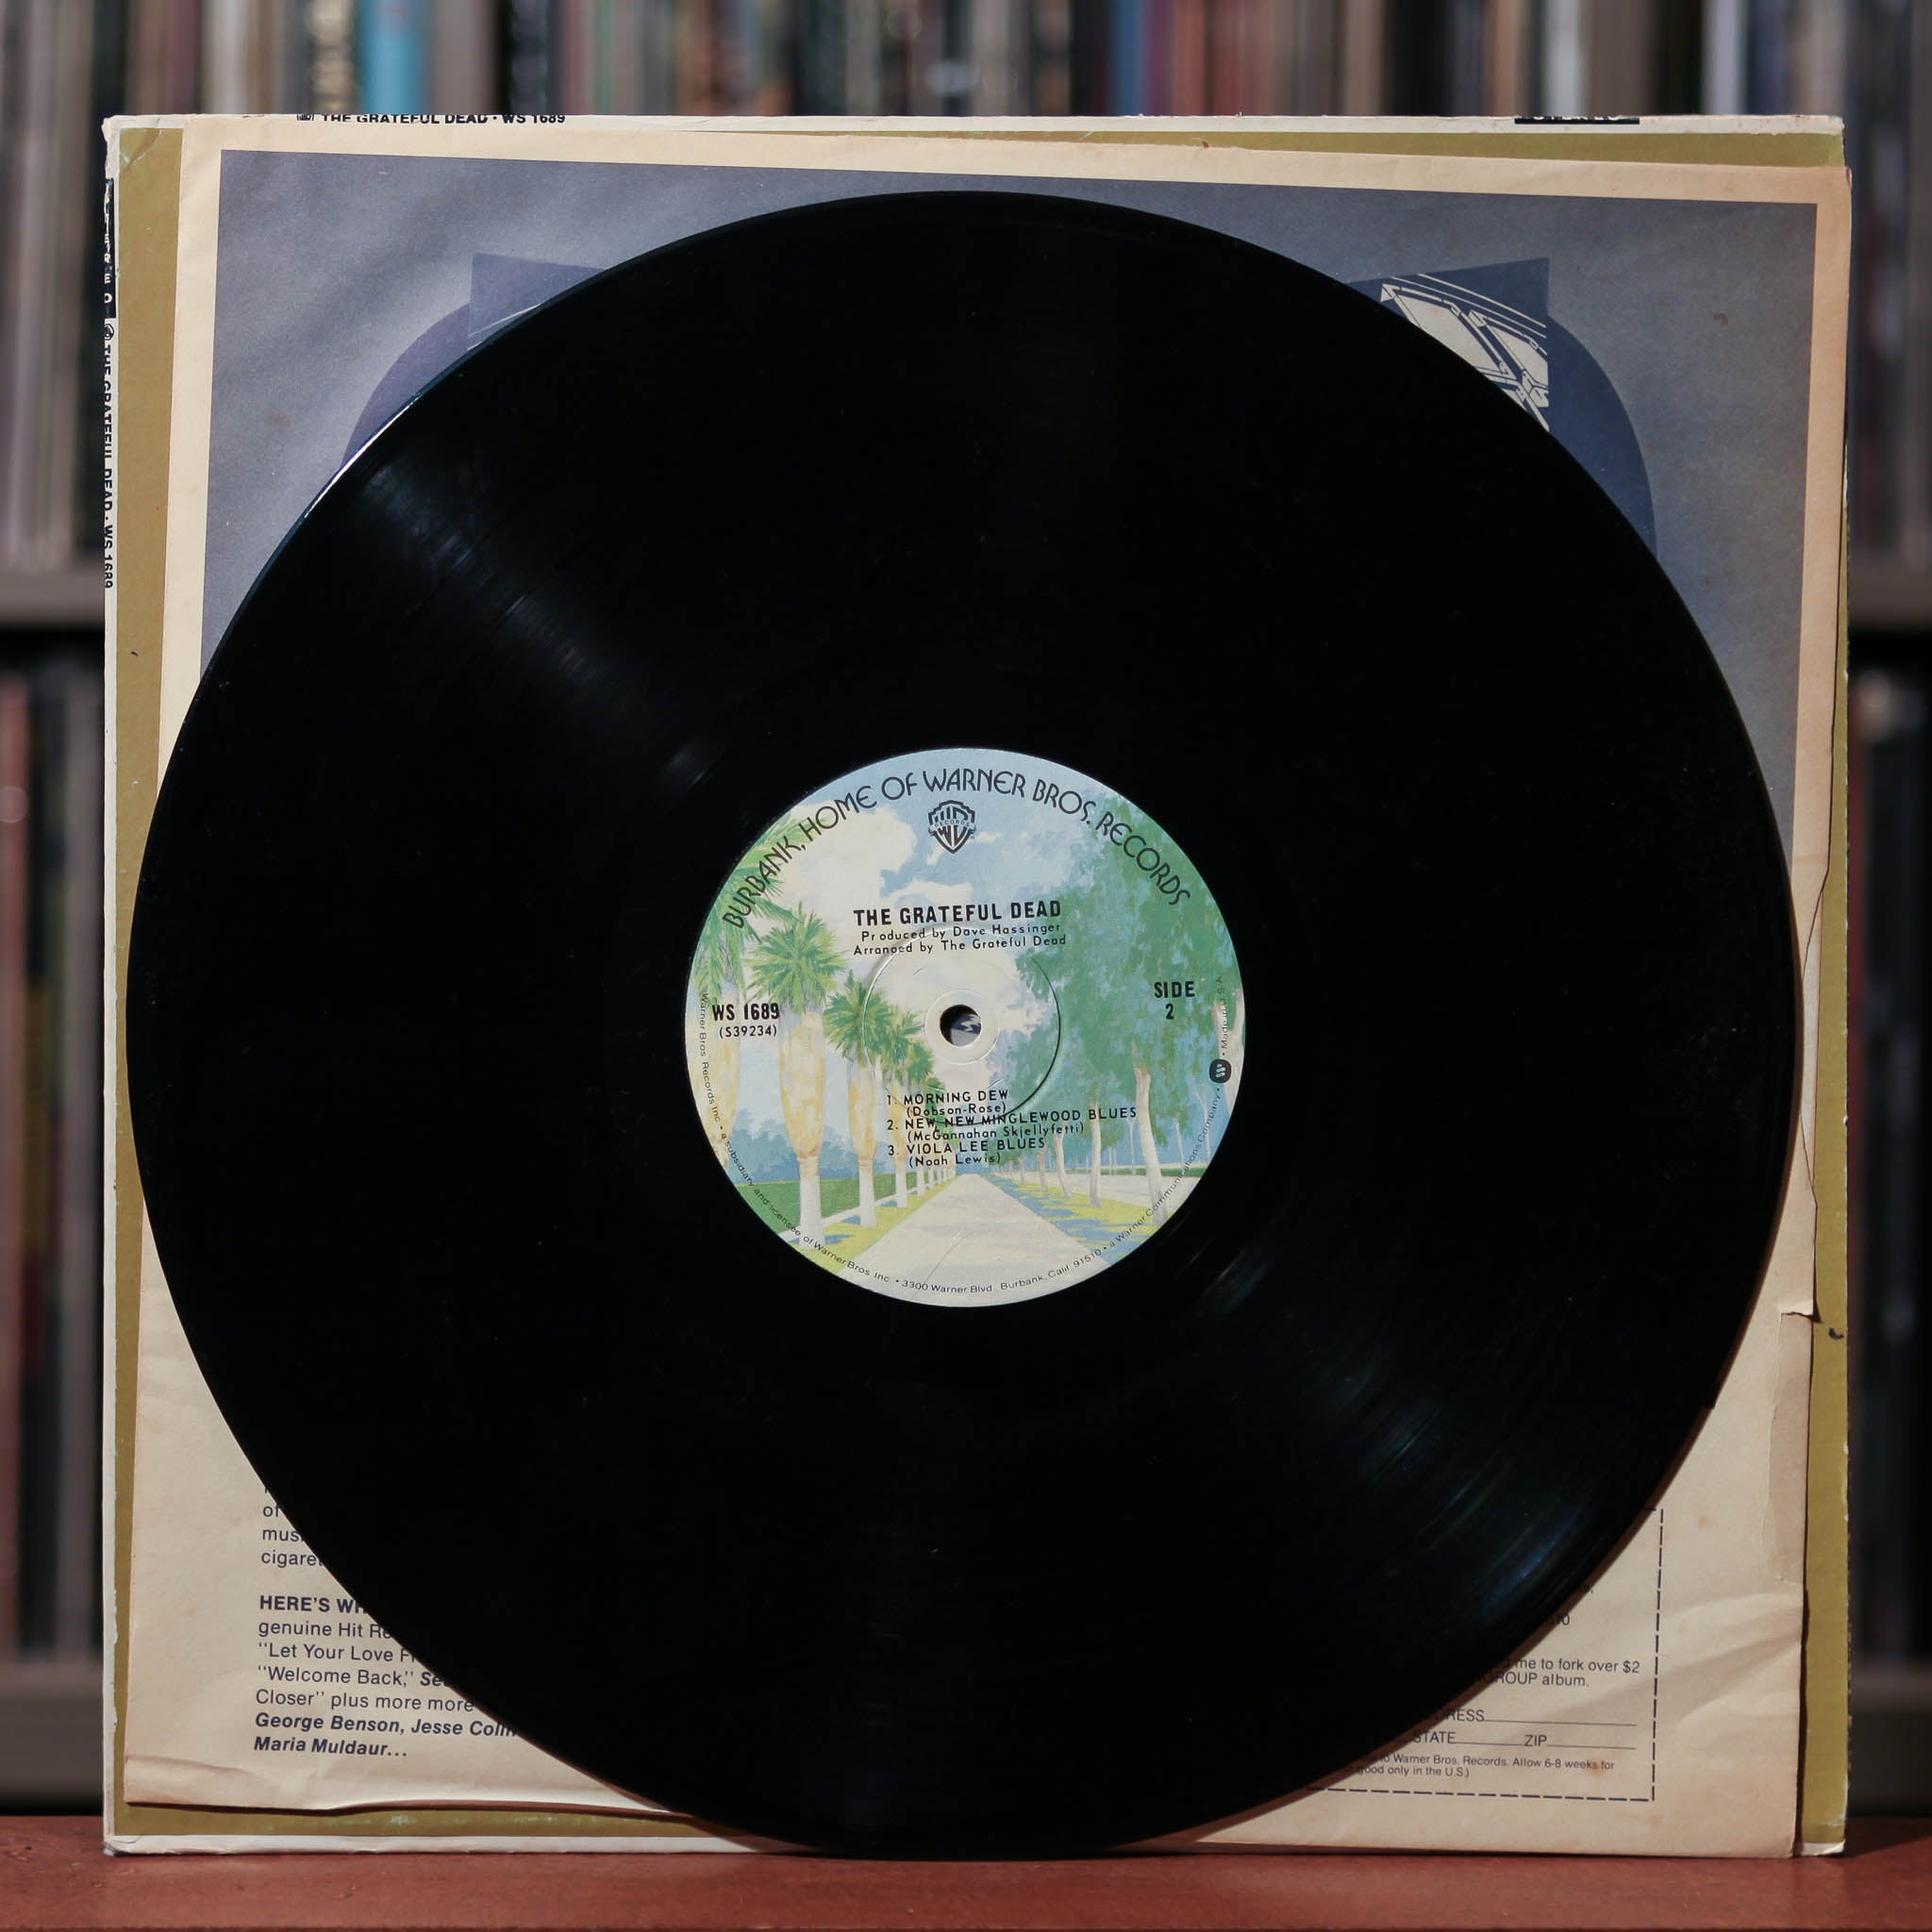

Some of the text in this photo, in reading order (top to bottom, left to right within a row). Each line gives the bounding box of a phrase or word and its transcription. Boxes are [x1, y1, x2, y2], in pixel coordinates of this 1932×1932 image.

[357, 114, 440, 124] GRATEFUL
[444, 114, 488, 124] DEAD
[502, 114, 526, 124] WS
[532, 114, 565, 124] 1689
[934, 819, 971, 828] RECORDS
[723, 768, 1191, 929] BURBANK, HOME OF WARNER BROS. RECORDS
[853, 900, 1061, 926] THE GRATEFUL DEAD
[861, 923, 1061, 942] Produced by Dave Hassinger
[920, 941, 934, 954] by
[941, 939, 966, 952] The
[973, 936, 1025, 950] Grateful
[1033, 934, 1066, 946] Dead
[1154, 980, 1195, 998] SIDE
[711, 1002, 780, 1022] WS 1689
[1165, 1003, 1174, 1020] 2
[719, 1024, 777, 1039] (S39234)
[887, 1090, 1008, 1105] 1. MORNING DEW
[887, 1120, 898, 1130] 2.
[944, 1117, 974, 1128] NEW
[981, 1110, 1081, 1126] MINGLEWOOD
[1089, 1108, 1137, 1121] BLUES
[907, 1104, 1007, 1118] (Dobson-Rose)
[908, 1128, 997, 1142] (McGannahan
[888, 1138, 1045, 1157] 3. VIOLA LEE BLUES
[908, 1153, 1002, 1169] (Noah Lewis)
[702, 1061, 715, 1105] Records
[803, 1235, 814, 1244] of
[813, 1240, 847, 1265] Warner
[901, 1279, 928, 1291] 3300
[930, 1285, 968, 1294] Warner
[262, 1528, 304, 1542] mus
[259, 1594, 331, 1613] HERE'S
[258, 1620, 332, 1638] genuine
[339, 1622, 363, 1639] Hit
[303, 1643, 344, 1659] Your
[351, 1645, 393, 1662] Love
[1515, 1658, 1537, 1670] me
[1541, 1657, 1554, 1670] to
[1558, 1657, 1584, 1671] fork
[1588, 1660, 1618, 1672] over
[1623, 1660, 1641, 1674] $2
[331, 1692, 369, 1710] plus
[375, 1695, 422, 1710] more
[427, 1698, 475, 1712] more
[255, 1712, 325, 1733] George
[330, 1715, 405, 1736] Benson,
[411, 1719, 463, 1736] Jesse
[254, 1736, 408, 1757] Maria Muldaur...
[1524, 1734, 1547, 1747] ZIP
[1387, 1765, 1410, 1777] only
[1412, 1766, 1423, 1774] in
[1425, 1767, 1442, 1776] the
[1392, 1754, 1431, 1764] Warner
[1512, 1757, 1541, 1768] Allow
[1544, 1757, 1562, 1769] 6-8
[1564, 1758, 1601, 1770] weeks
[1601, 1758, 1615, 1771] for
